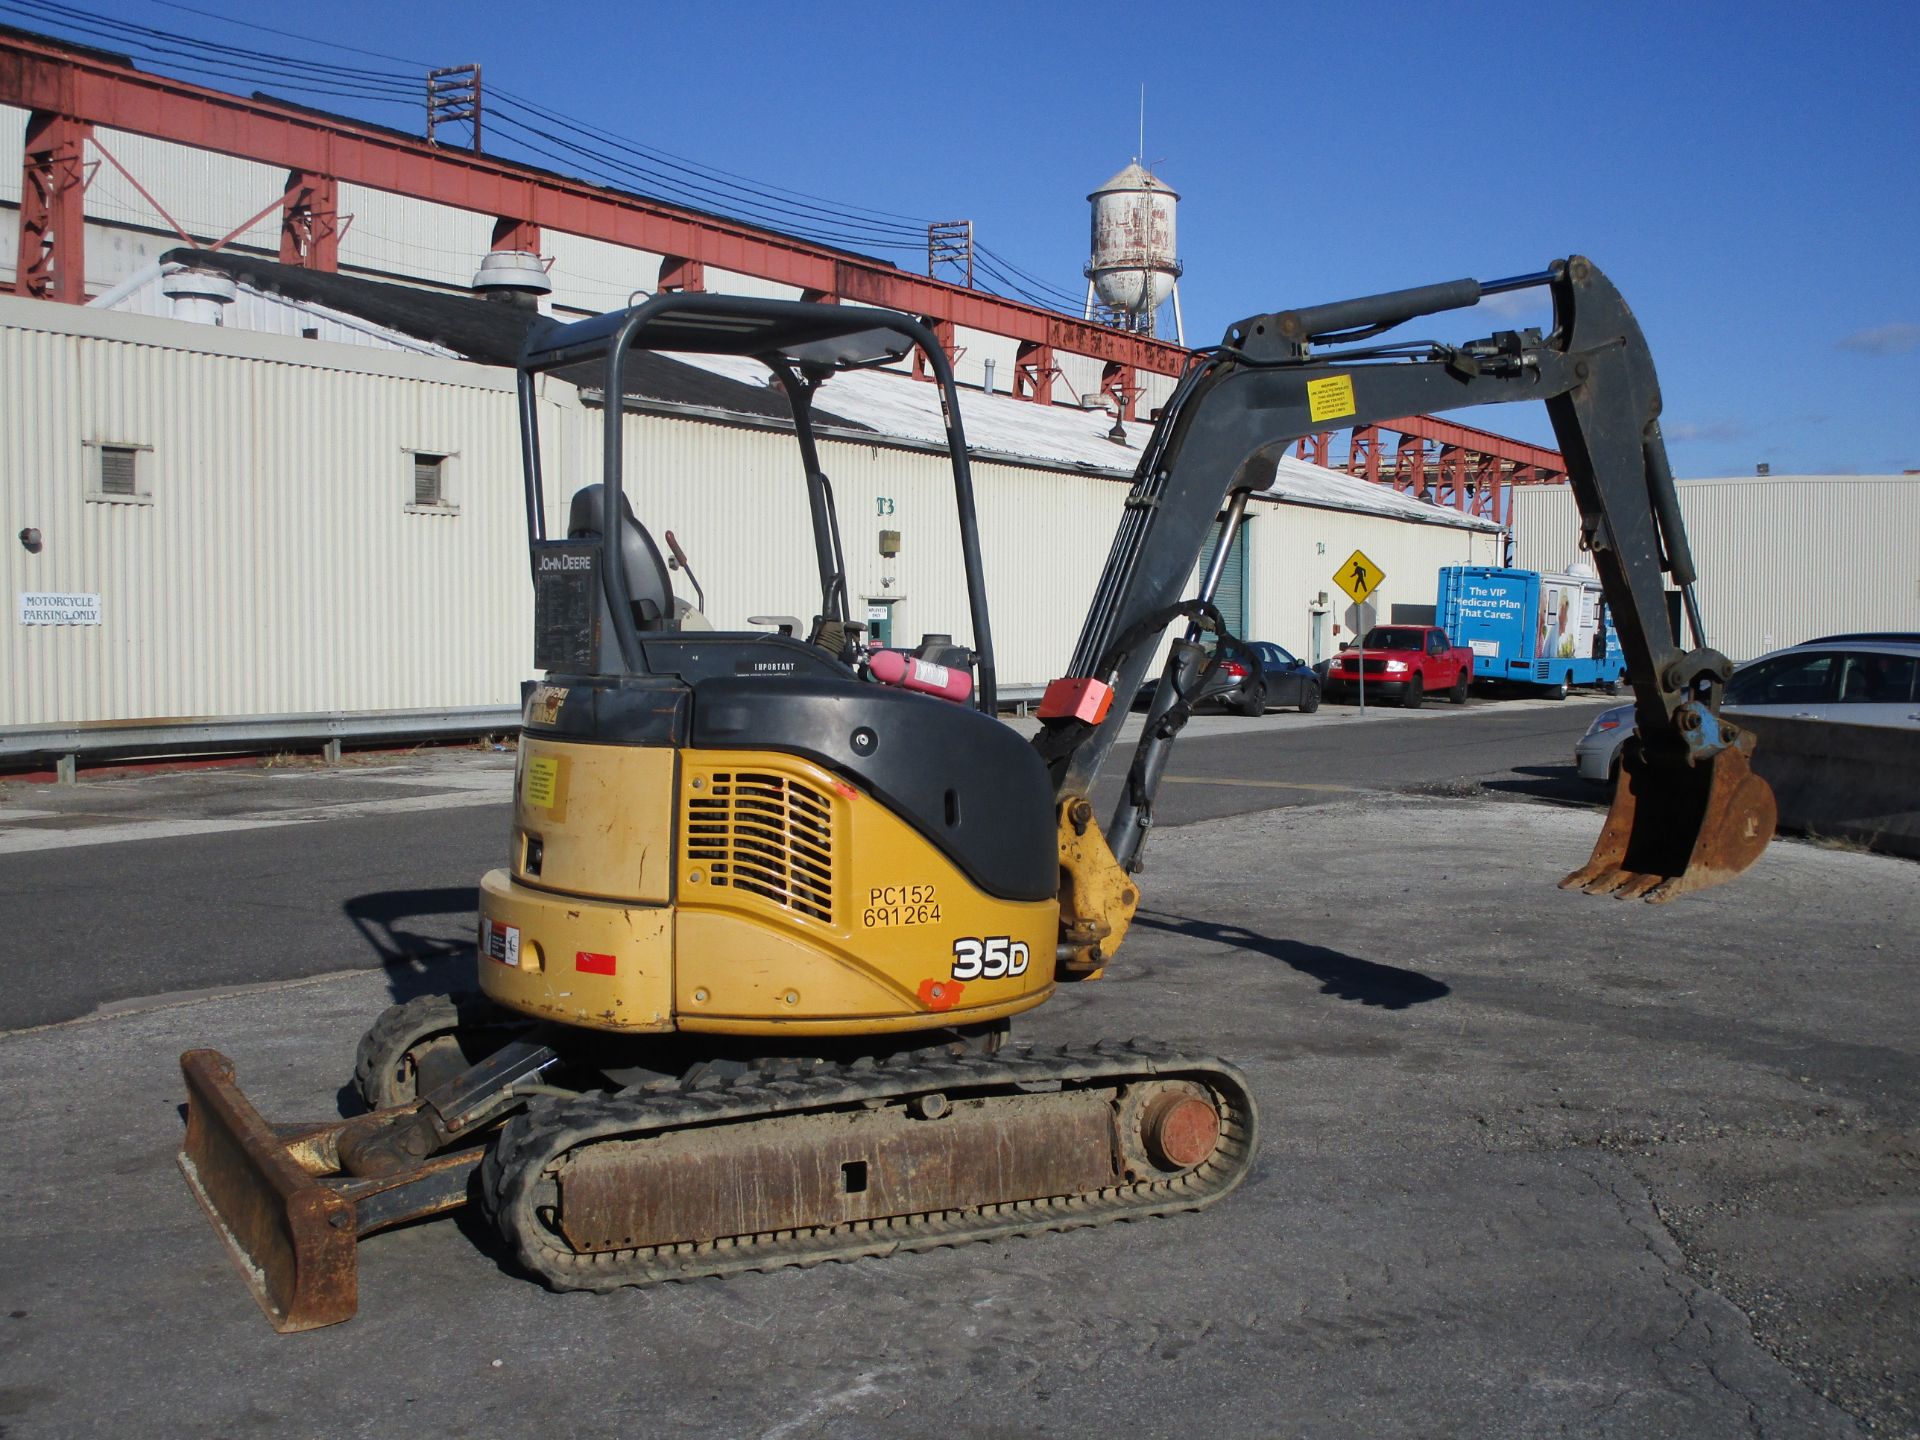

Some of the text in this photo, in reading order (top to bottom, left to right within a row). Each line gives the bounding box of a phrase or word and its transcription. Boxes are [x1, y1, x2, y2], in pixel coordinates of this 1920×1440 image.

[876, 497, 895, 516] T3
[538, 554, 591, 571] JOHN DEERE
[1469, 587, 1507, 597] The VIP
[26, 596, 93, 607] MOTORCYCLE
[1499, 600, 1520, 609] Plan
[24, 610, 97, 620] PARKING ONLY
[1460, 608, 1514, 620] That Cares.
[754, 663, 795, 671] IMPORTANT
[870, 885, 935, 906] PC152
[863, 904, 941, 927] 691264
[951, 935, 1030, 981] 35D
